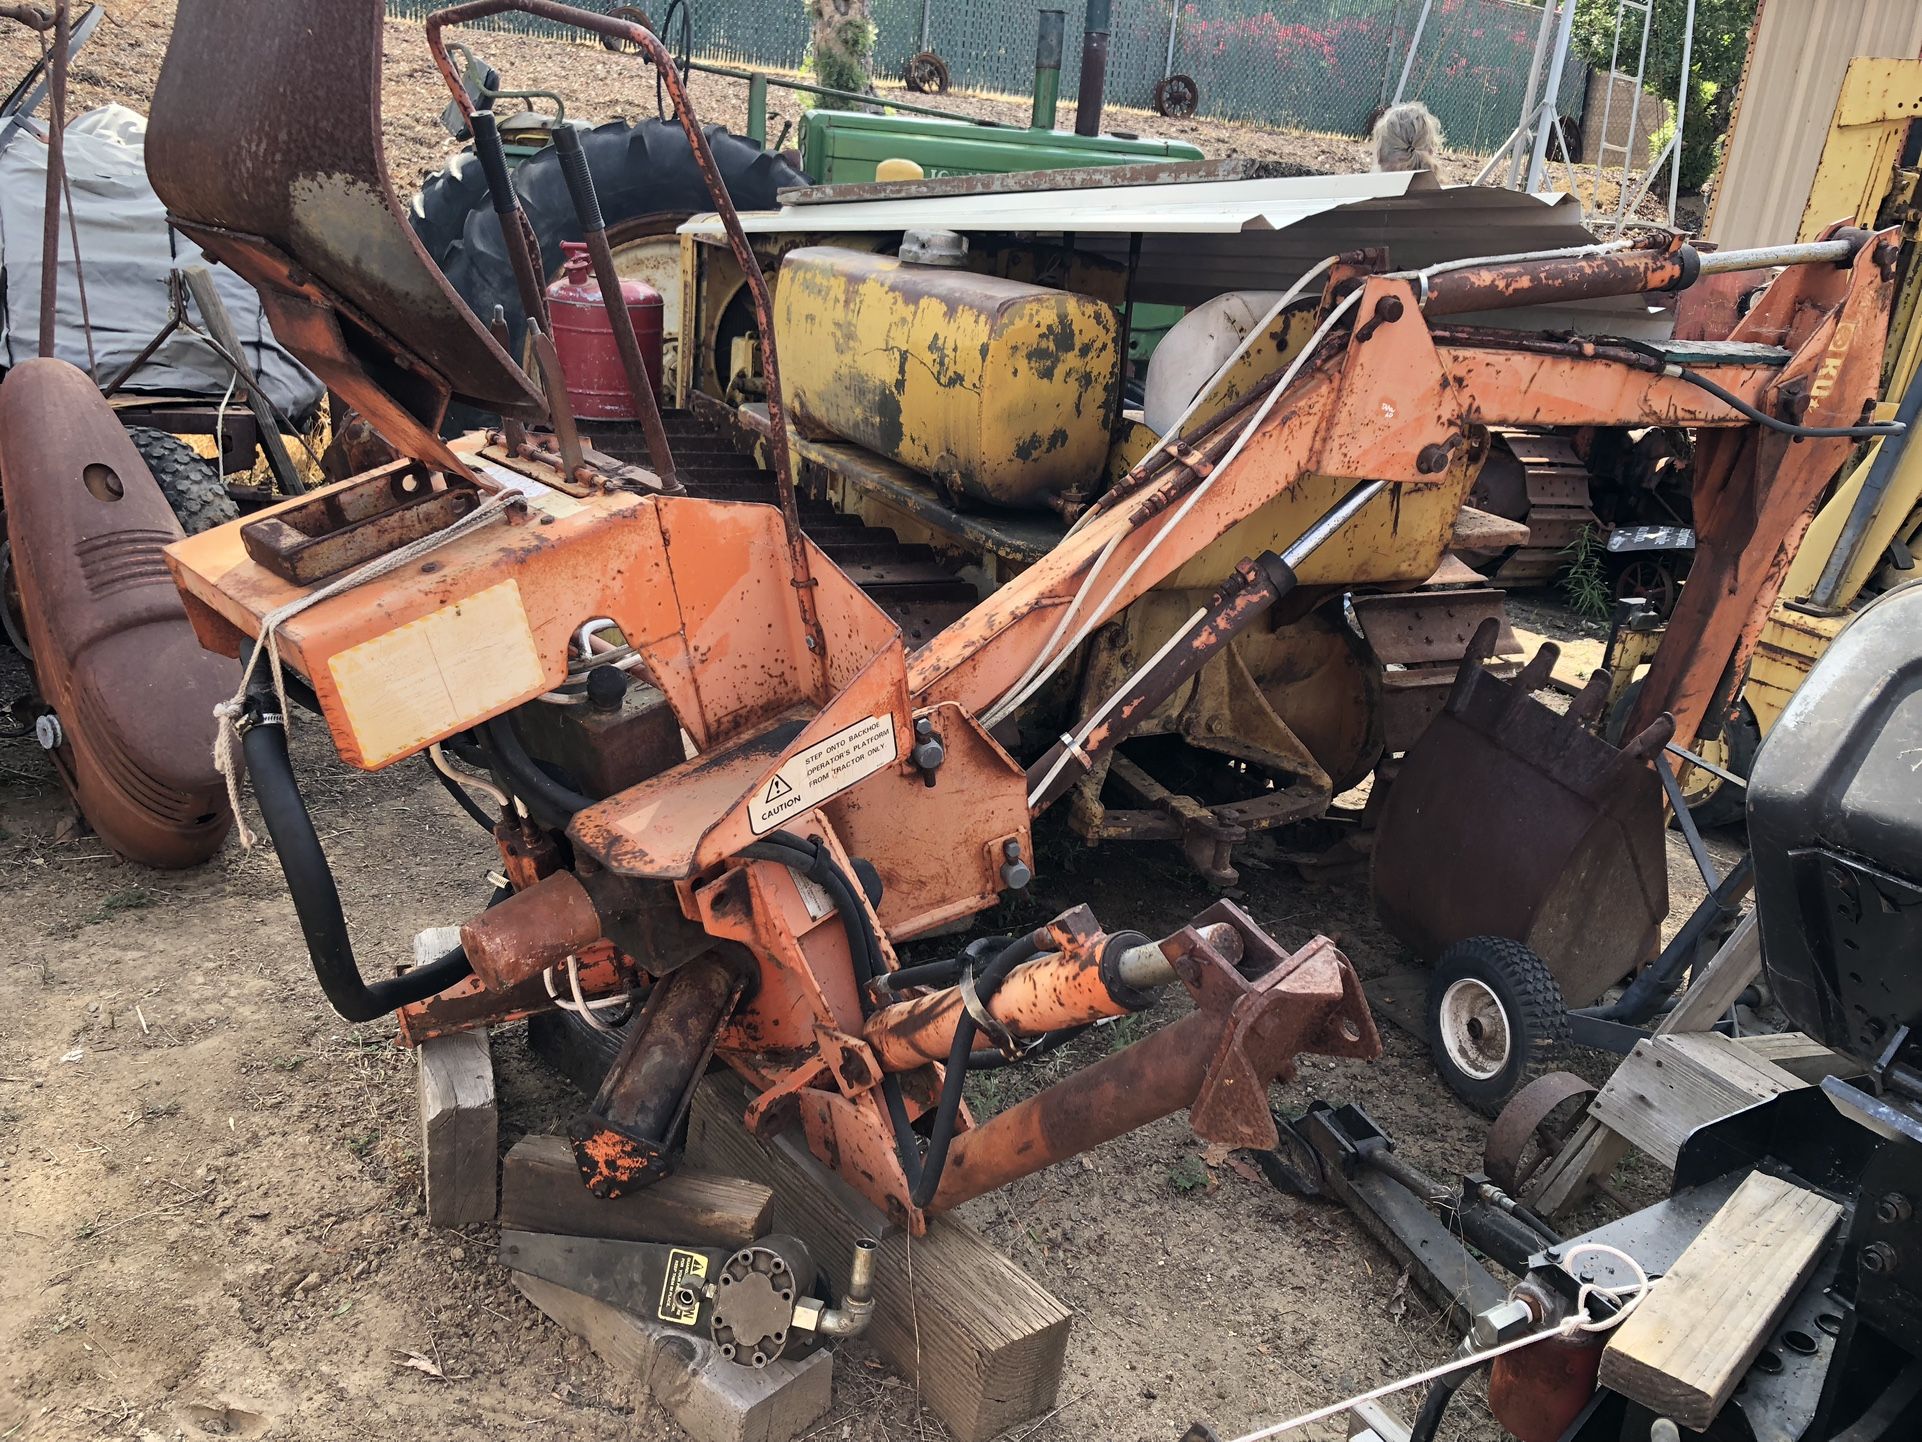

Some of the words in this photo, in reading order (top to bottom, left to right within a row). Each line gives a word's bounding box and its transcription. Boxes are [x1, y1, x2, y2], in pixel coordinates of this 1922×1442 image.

[805, 751, 823, 765] STEP
[826, 739, 846, 754] ONTO
[848, 721, 881, 742] BACKHOE
[806, 750, 850, 776] OPERATOR'S
[853, 728, 890, 752] PLATFORM
[808, 772, 830, 788] FROM
[832, 753, 865, 774] TRACTOR
[761, 794, 801, 821] CAUTION
